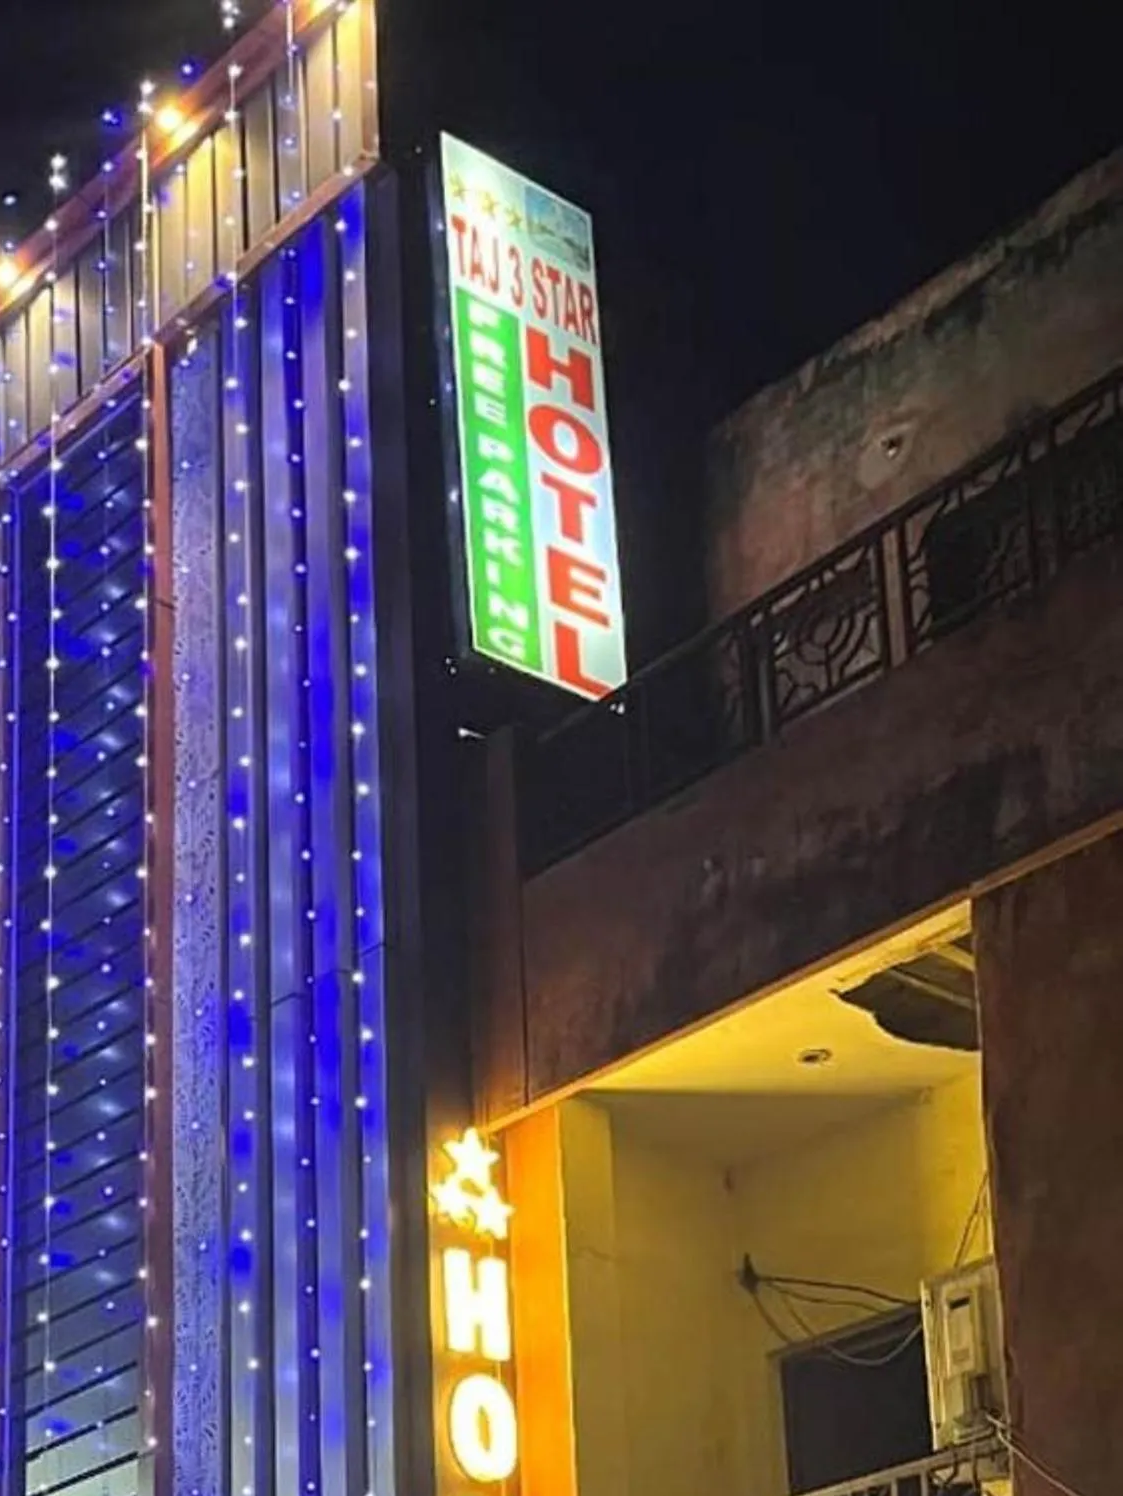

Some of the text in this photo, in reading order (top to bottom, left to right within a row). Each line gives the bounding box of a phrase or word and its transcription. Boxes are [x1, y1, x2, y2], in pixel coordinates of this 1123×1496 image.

[451, 214, 597, 347] TAJ 3 STAR
[477, 433, 528, 662] PARKING
[526, 325, 613, 699] HOTEL
